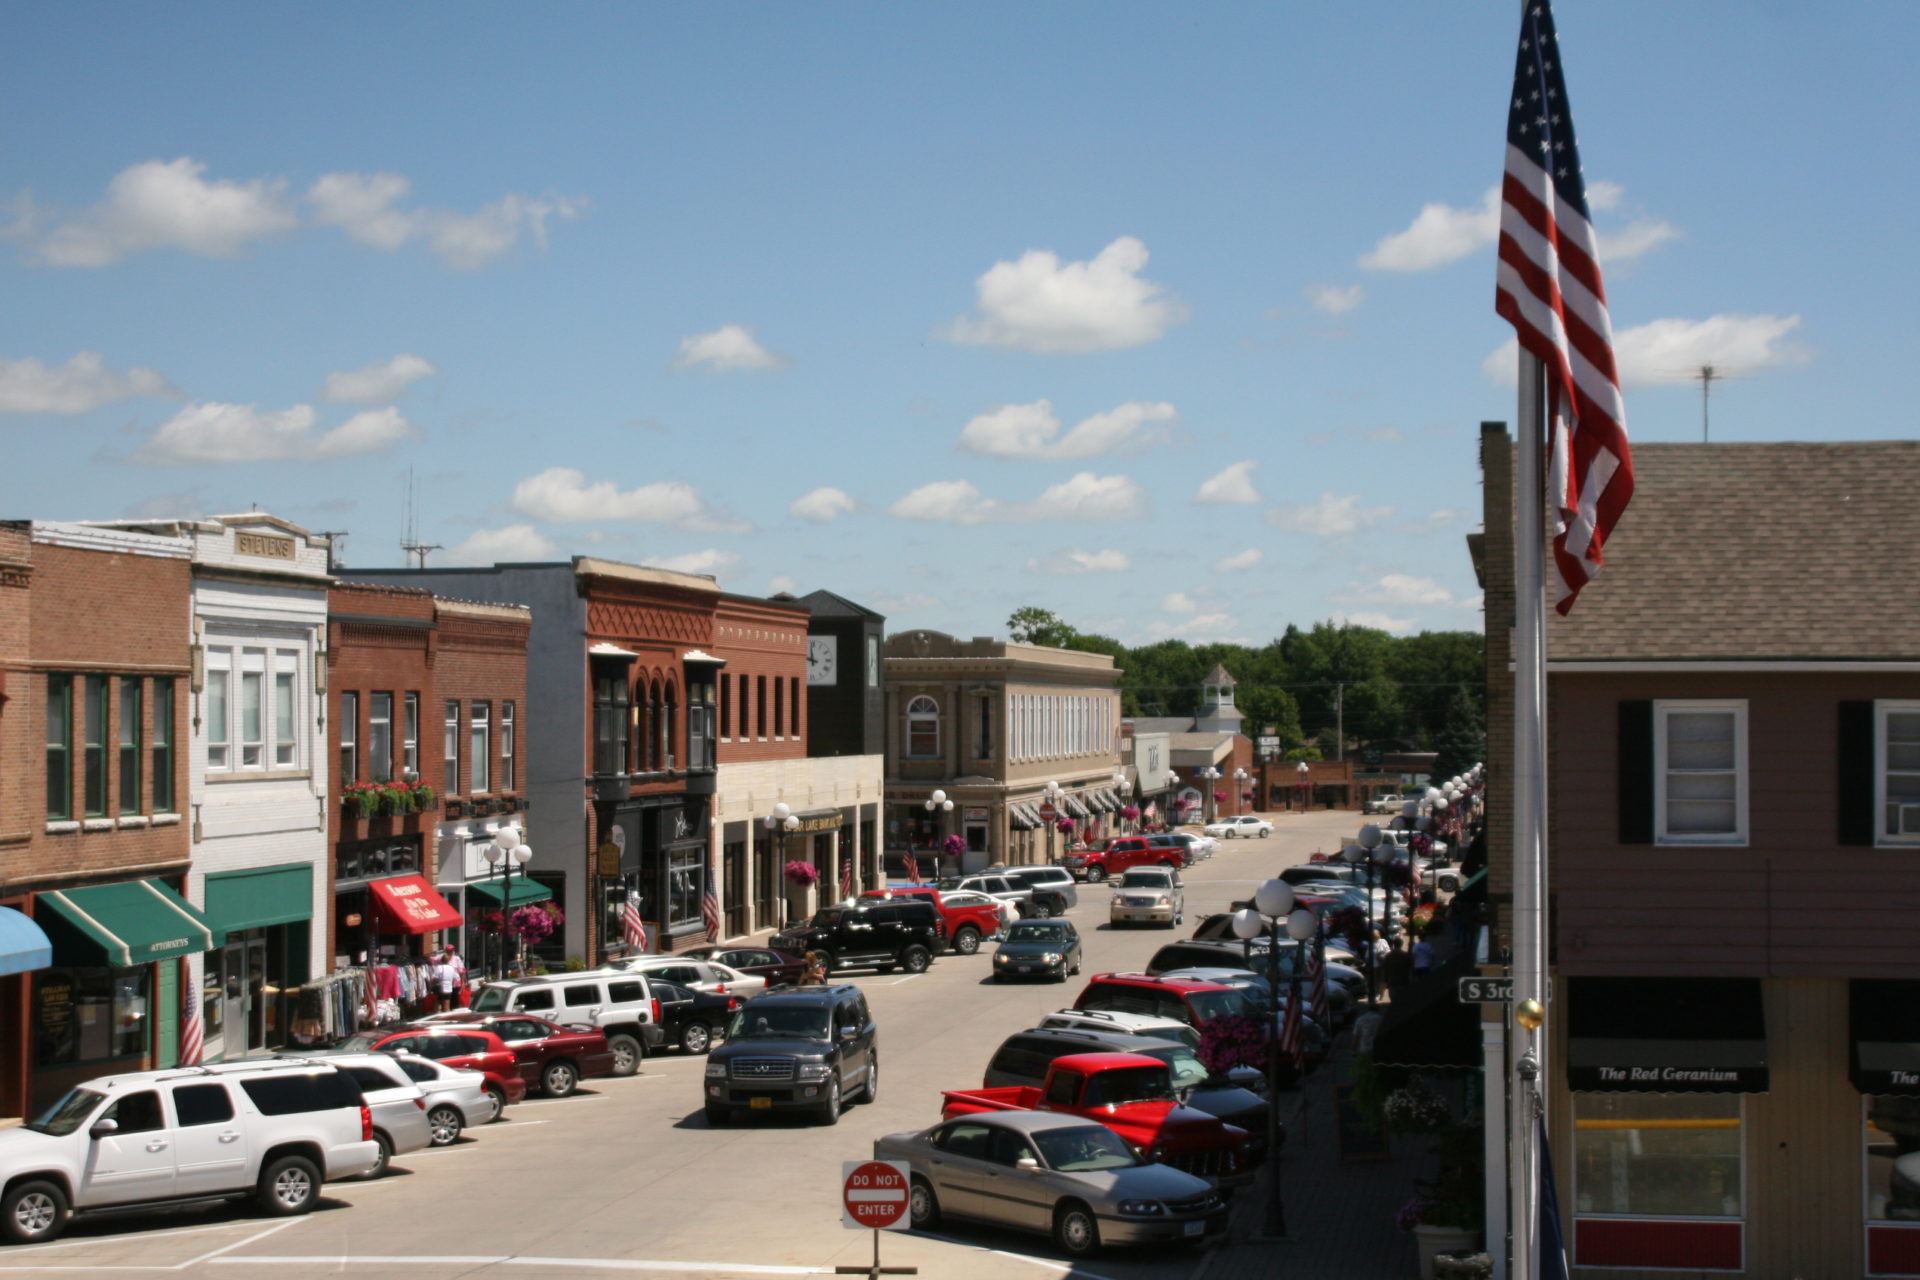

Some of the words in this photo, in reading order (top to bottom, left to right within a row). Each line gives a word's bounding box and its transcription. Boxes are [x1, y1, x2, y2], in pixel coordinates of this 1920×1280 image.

[240, 535, 289, 557] STEVENS
[151, 937, 189, 952] ATTORNEYS
[1468, 982, 1481, 999] S
[1599, 1066, 1627, 1081] The
[1630, 1066, 1660, 1081] Red
[1662, 1066, 1739, 1081] Geranium
[1890, 1071, 1920, 1085] The
[853, 1175, 869, 1186] DO
[876, 1175, 900, 1186] NOT
[857, 1204, 896, 1216] ENTER
